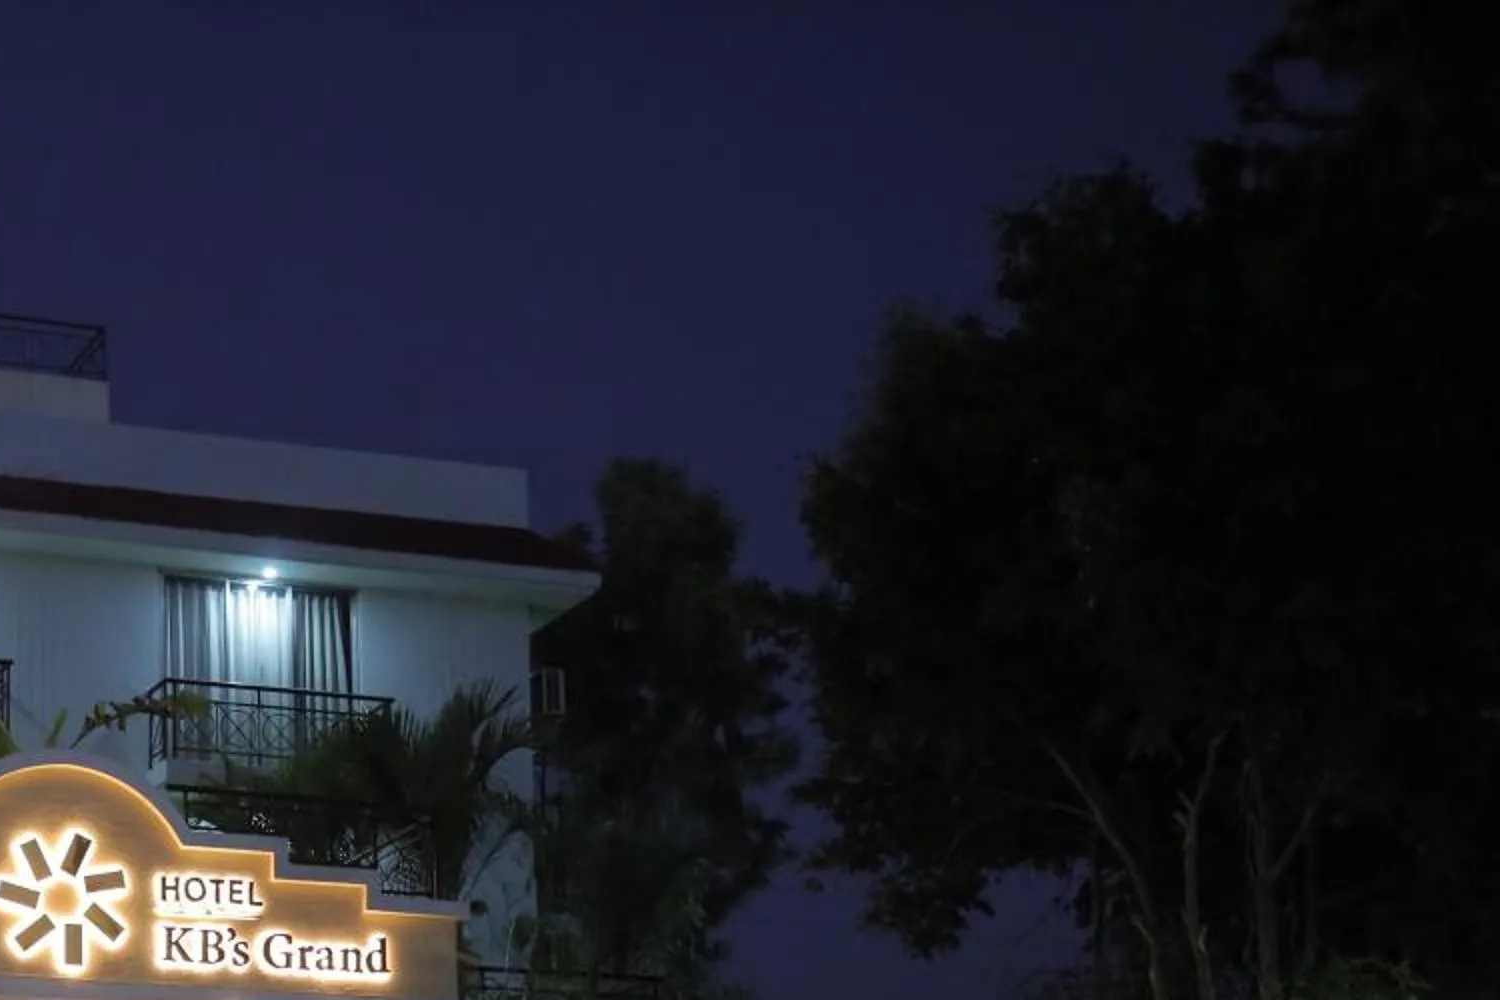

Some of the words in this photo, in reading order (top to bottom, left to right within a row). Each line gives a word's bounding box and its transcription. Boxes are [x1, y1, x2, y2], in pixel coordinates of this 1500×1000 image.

[160, 875, 264, 907] HOTEL
[162, 925, 251, 967] KB's
[263, 932, 392, 974] Grand
